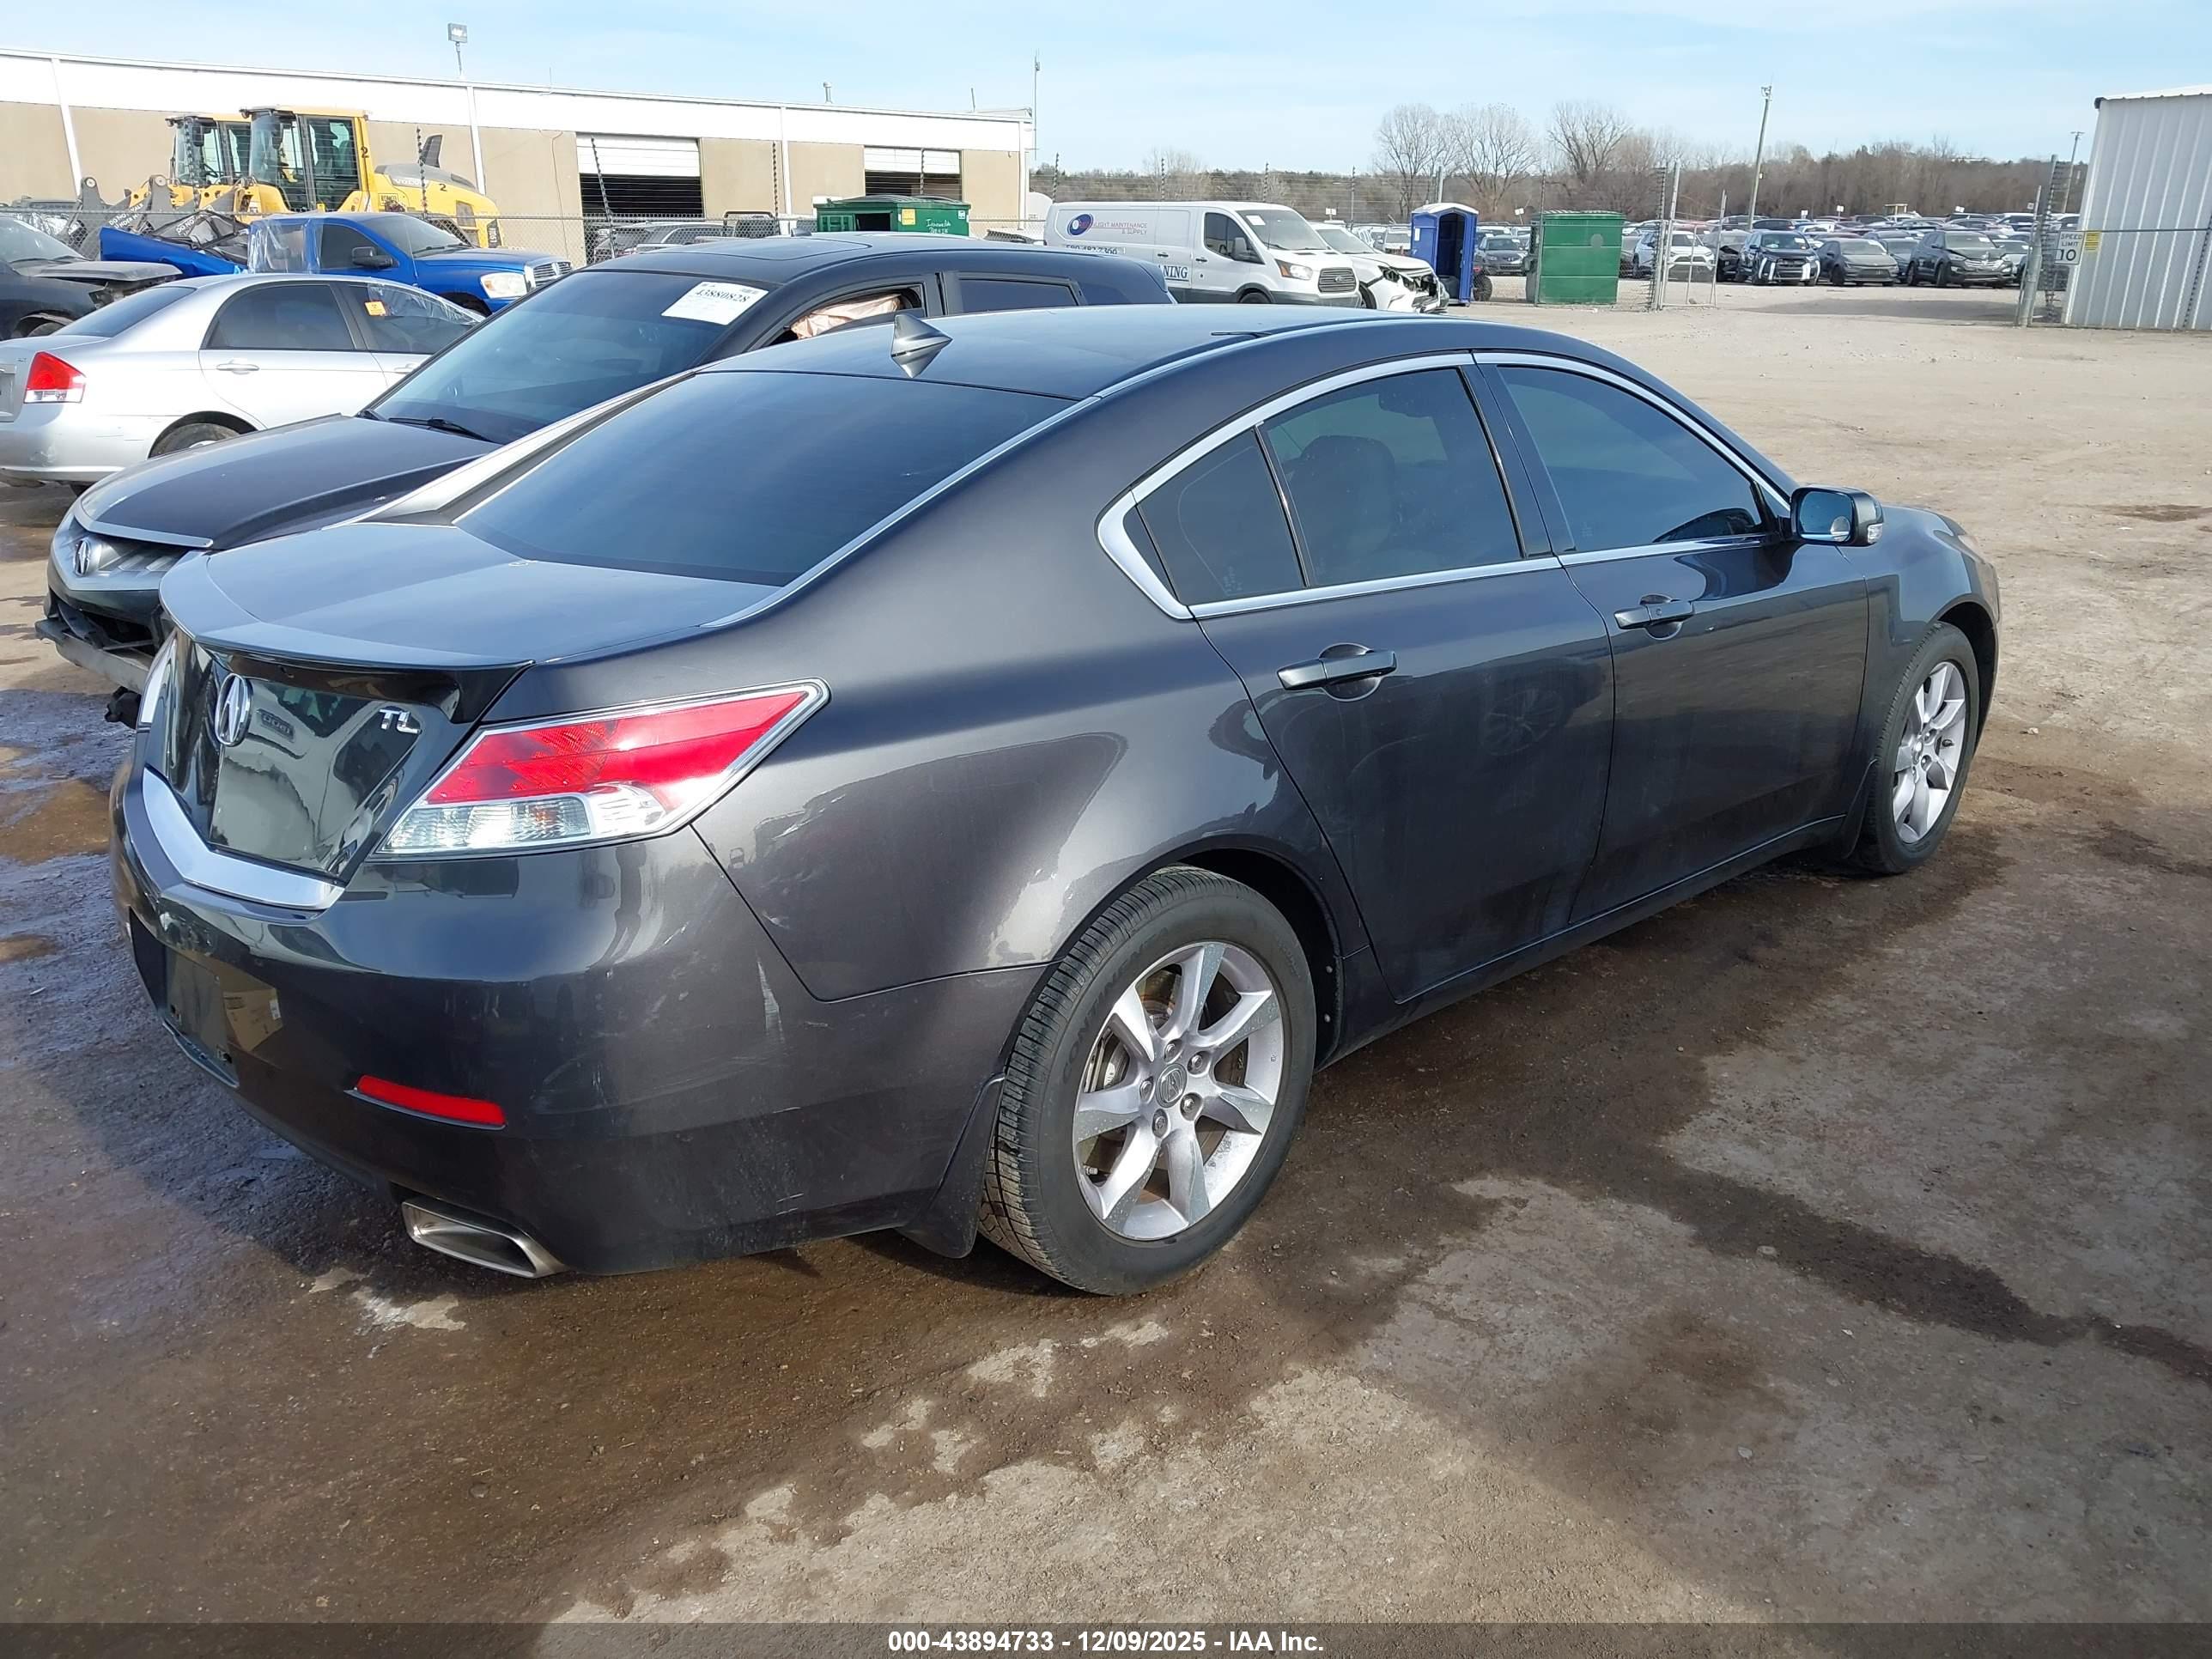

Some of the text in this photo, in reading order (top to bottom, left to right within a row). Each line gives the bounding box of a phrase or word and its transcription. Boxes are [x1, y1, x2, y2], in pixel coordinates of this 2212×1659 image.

[360, 146, 369, 159] 2
[439, 183, 447, 191] 2
[2060, 249, 2076, 261] 10
[379, 708, 419, 733] TL
